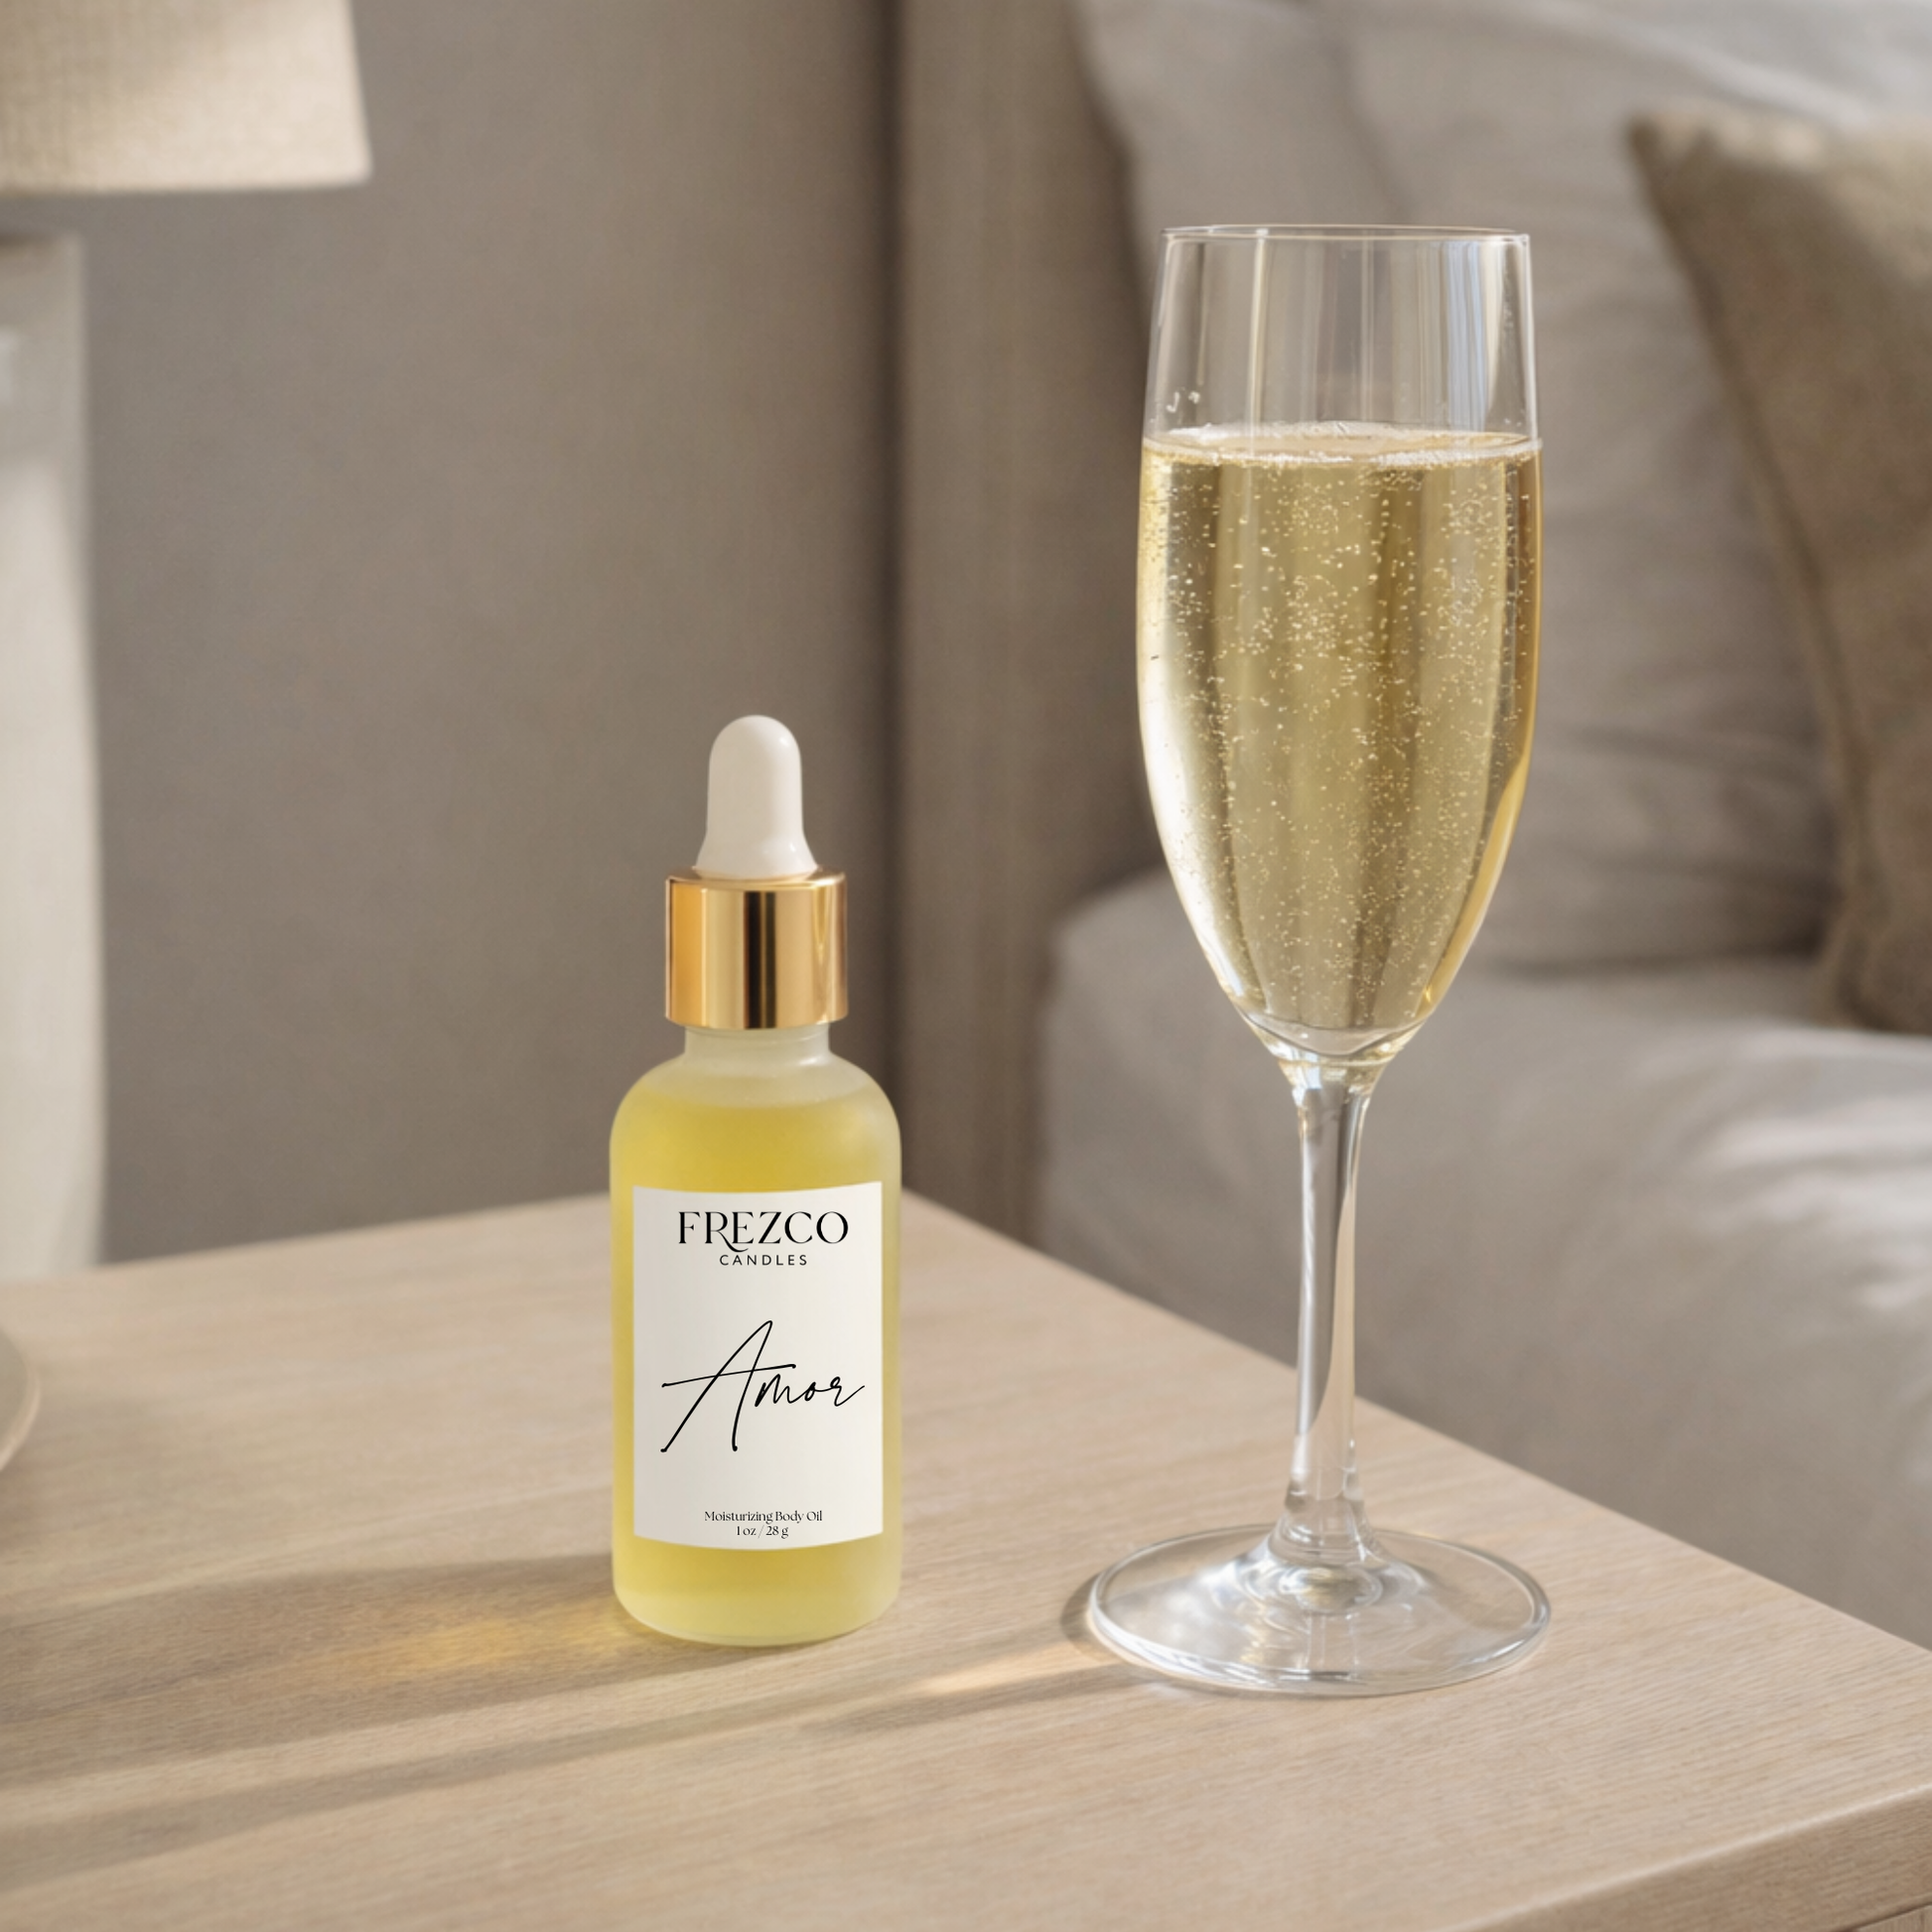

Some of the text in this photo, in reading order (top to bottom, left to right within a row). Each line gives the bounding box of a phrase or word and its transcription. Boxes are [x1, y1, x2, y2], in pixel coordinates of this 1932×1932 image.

[678, 1210, 849, 1253] FREZCO
[719, 1254, 808, 1266] CANDLES
[660, 1319, 865, 1453] Amor
[704, 1510, 823, 1525] Moisturizing Body Oil
[737, 1526, 741, 1536] 1
[743, 1527, 757, 1536] oz
[765, 1526, 779, 1536] 28
[780, 1527, 789, 1539] g
